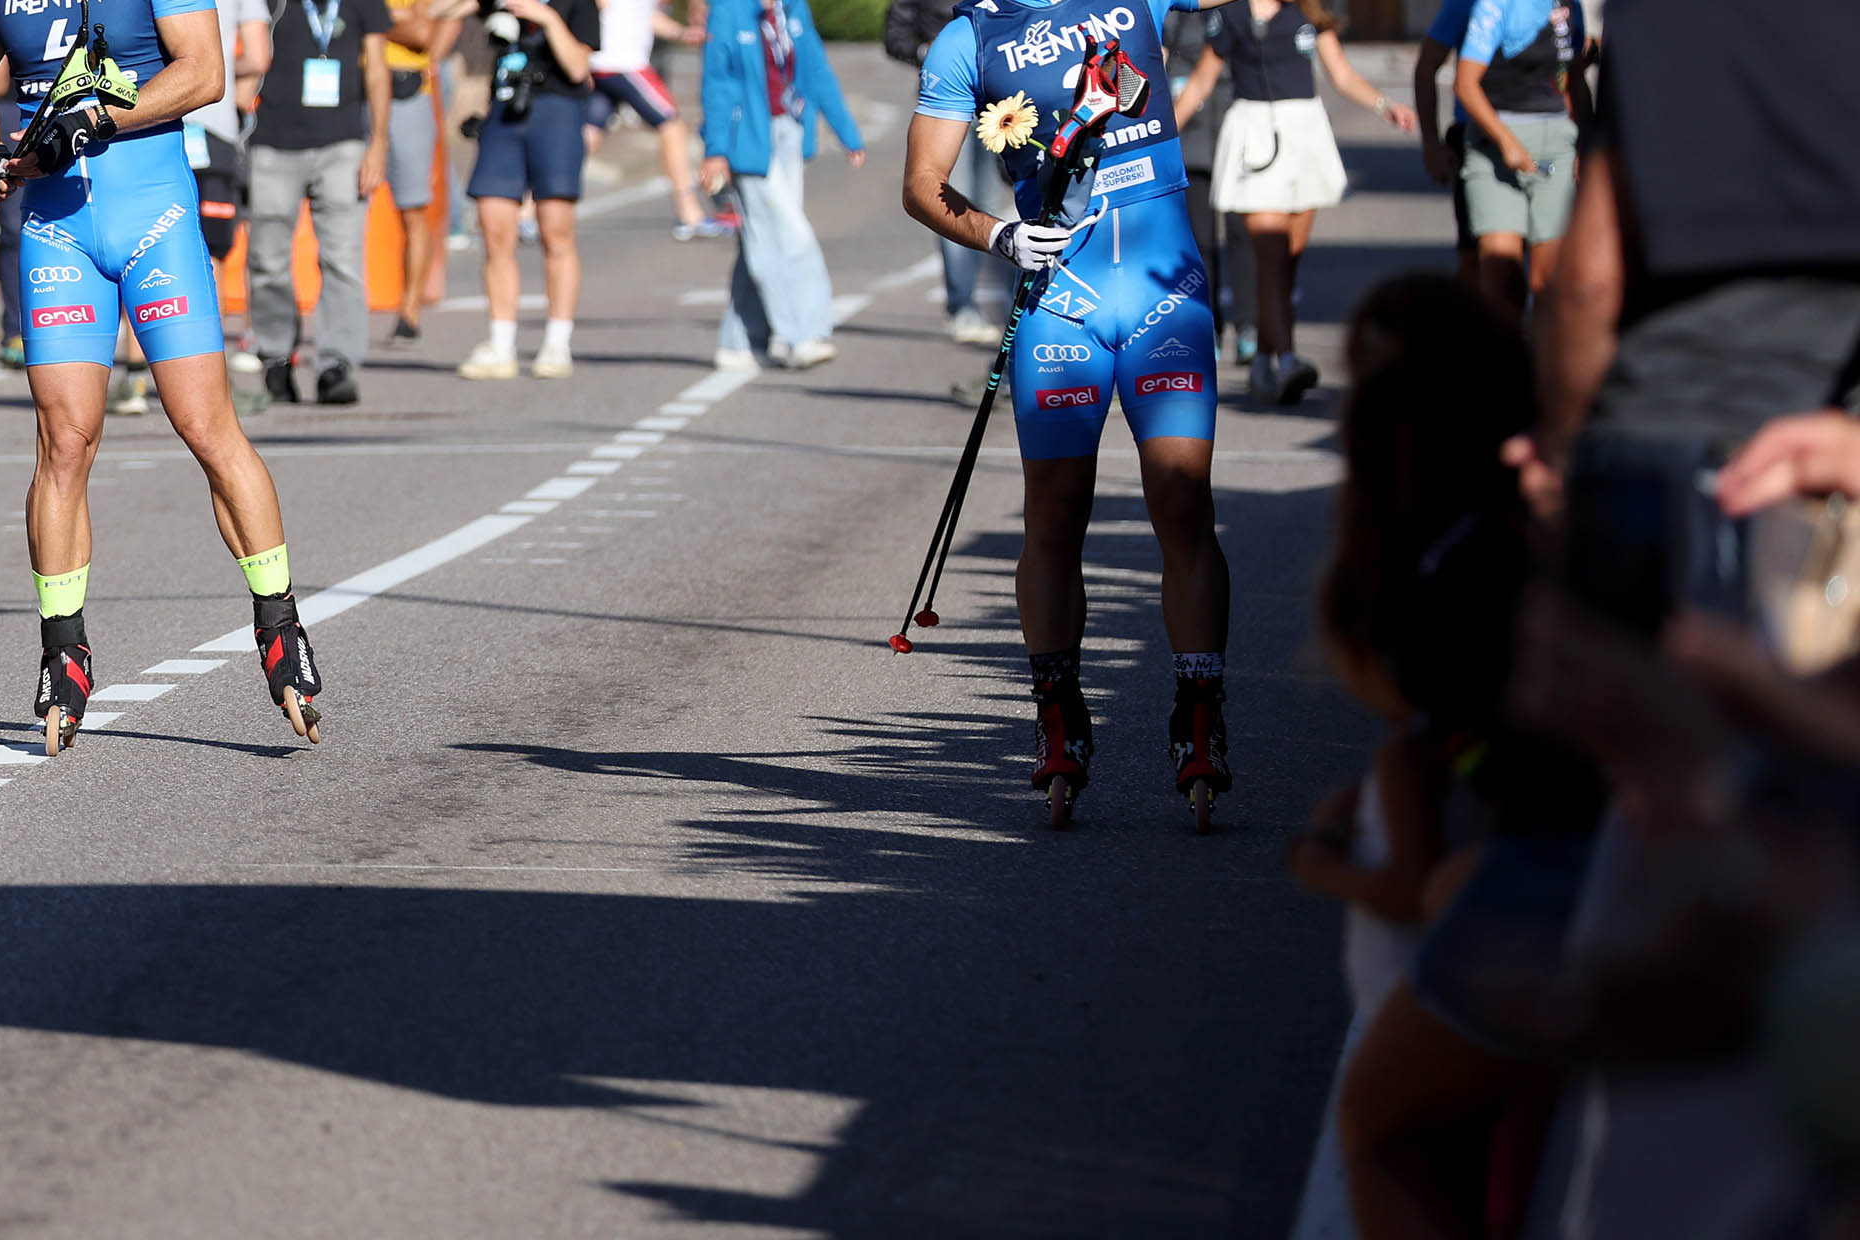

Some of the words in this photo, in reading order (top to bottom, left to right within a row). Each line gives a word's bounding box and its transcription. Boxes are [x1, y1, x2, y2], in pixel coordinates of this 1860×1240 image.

[43, 18, 78, 62] 4
[997, 6, 1136, 73] TRENTINO
[1101, 162, 1144, 181] DOLOMITI
[1102, 170, 1146, 189] SUPERSKI
[33, 285, 56, 294] Audi
[139, 278, 173, 291] AVIO
[38, 307, 90, 326] enel
[139, 299, 181, 321] enel
[1149, 348, 1190, 360] AVIO
[1037, 365, 1065, 374] Audi
[1141, 373, 1195, 392] enel
[1045, 388, 1095, 408] enel
